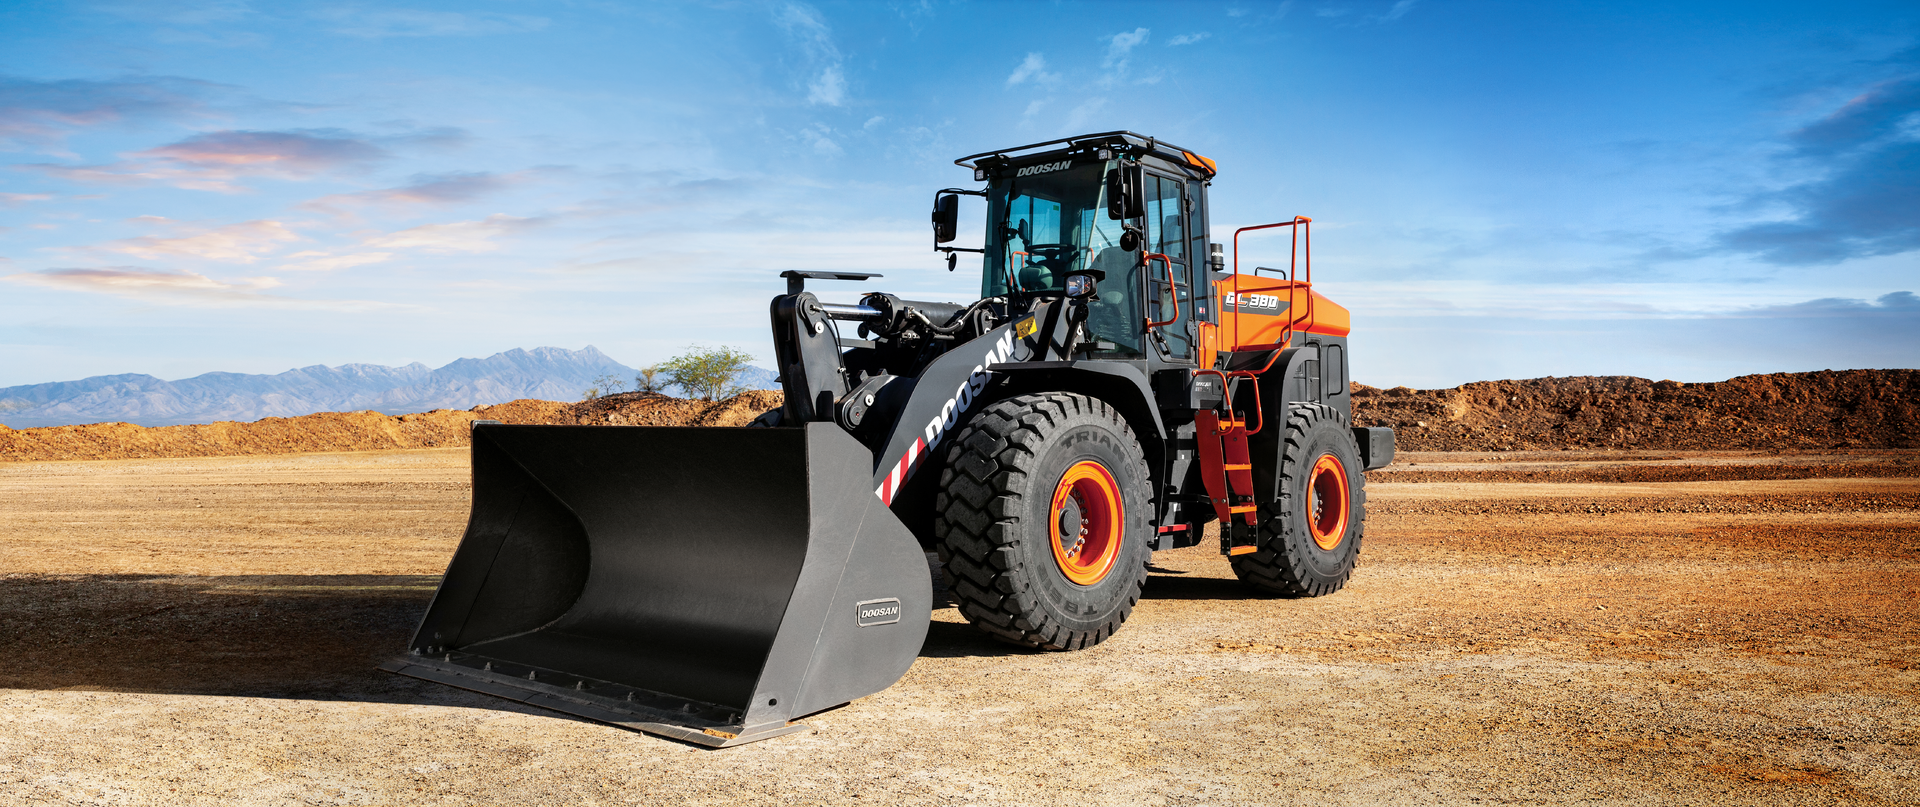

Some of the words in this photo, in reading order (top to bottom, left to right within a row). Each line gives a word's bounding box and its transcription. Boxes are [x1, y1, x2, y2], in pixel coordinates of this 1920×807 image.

[1016, 160, 1072, 178] DOOSAN
[1249, 294, 1279, 310] 380
[925, 328, 1014, 452] DOOSAN
[861, 606, 898, 618] DOOSAN
